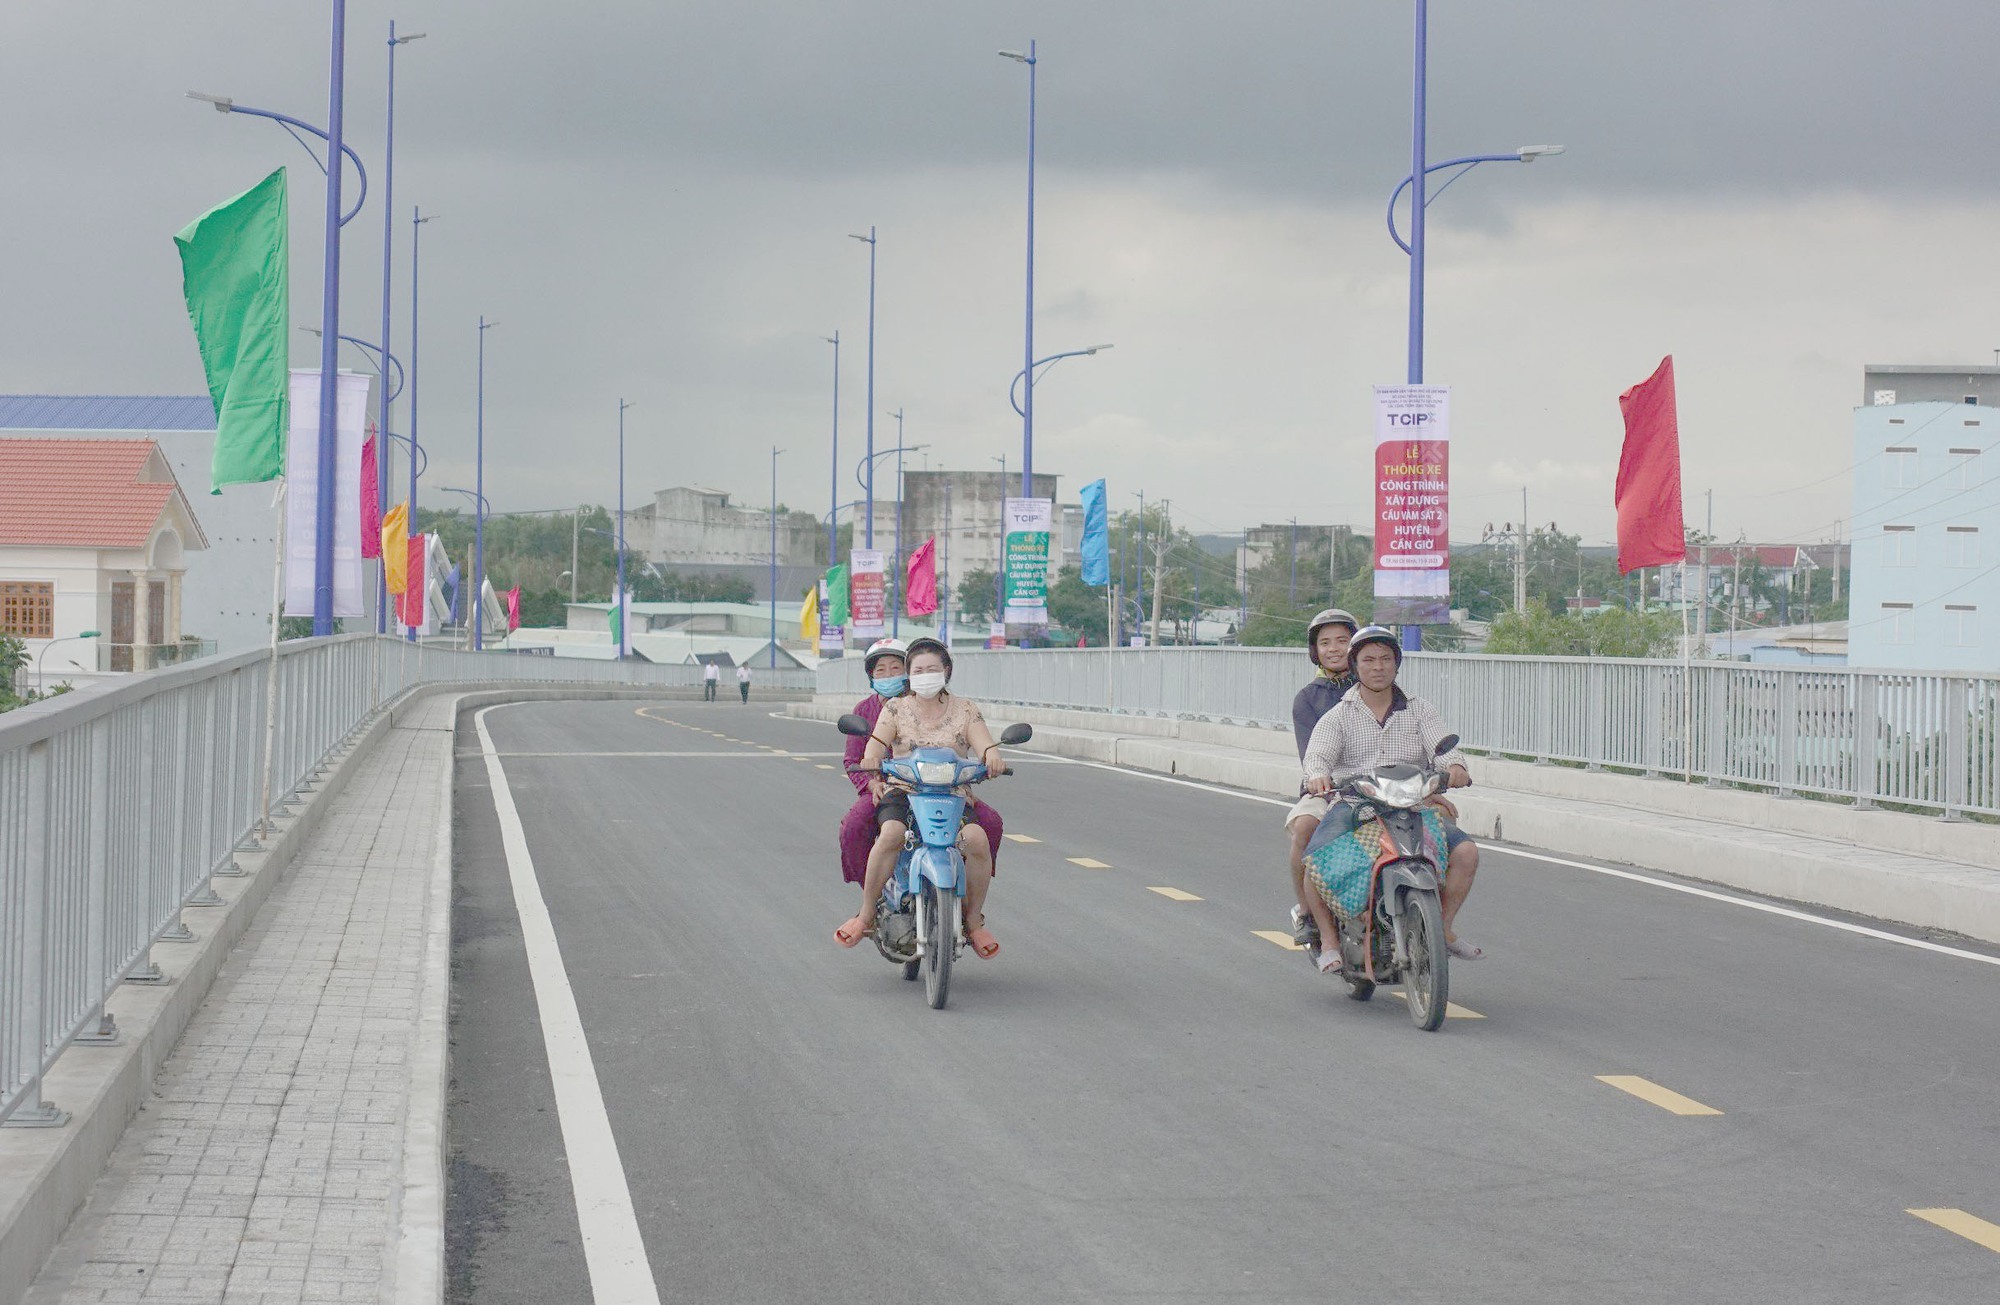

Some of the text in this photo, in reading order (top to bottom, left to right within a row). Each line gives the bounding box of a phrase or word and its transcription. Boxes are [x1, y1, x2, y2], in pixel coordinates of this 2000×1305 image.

[1387, 413, 1428, 426] TCIP
[1383, 463, 1442, 475] THÔNG XE
[1380, 478, 1444, 491] CÔNG TRÌNH
[1385, 494, 1439, 508] XÂY DỰNG
[1013, 514, 1039, 522] TCIP
[1401, 508, 1419, 520] VÀM
[1436, 510, 1442, 520] 2
[1394, 523, 1430, 538] HUYỆN
[1414, 538, 1434, 550] GIỜ
